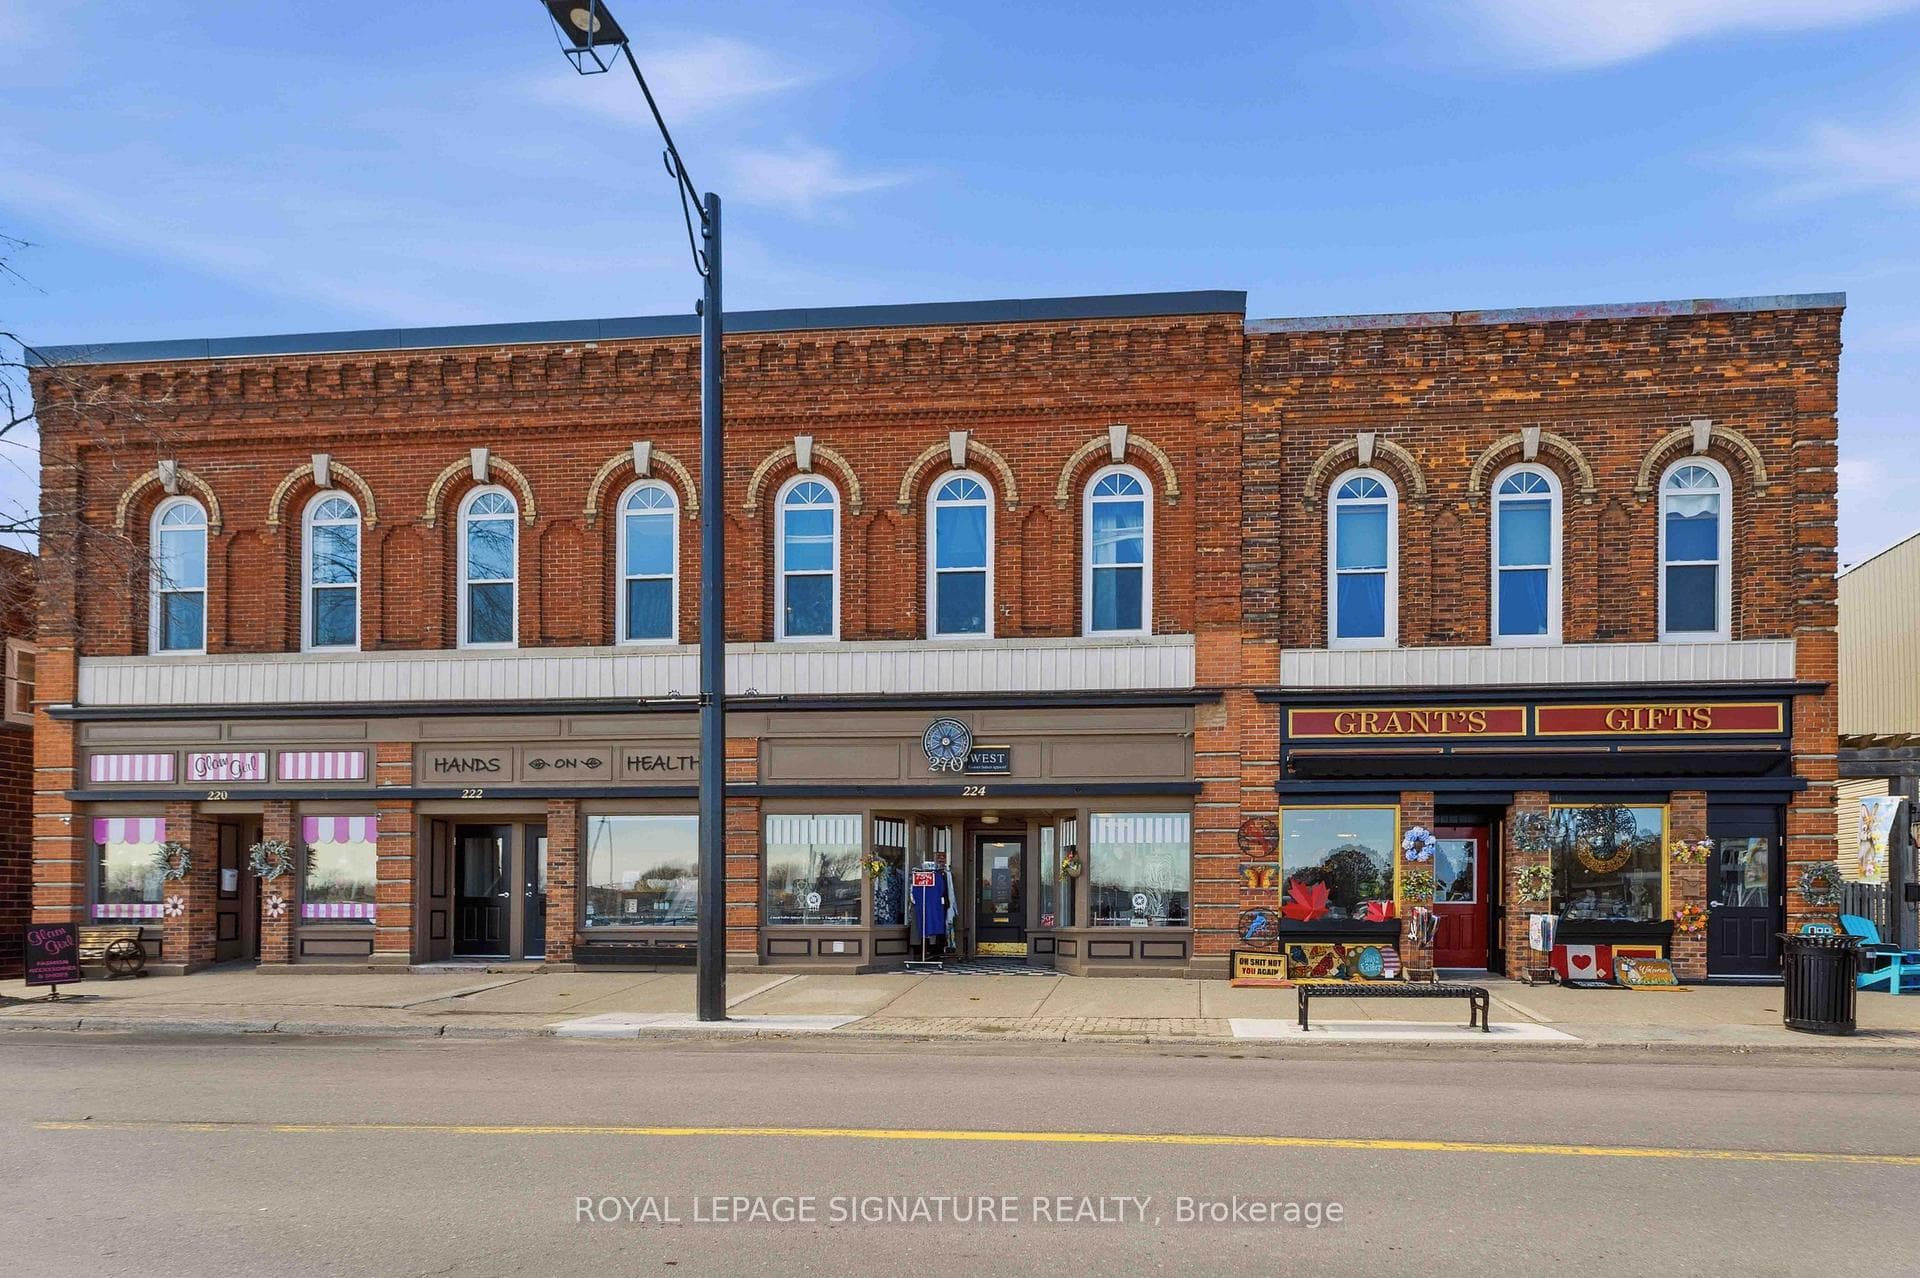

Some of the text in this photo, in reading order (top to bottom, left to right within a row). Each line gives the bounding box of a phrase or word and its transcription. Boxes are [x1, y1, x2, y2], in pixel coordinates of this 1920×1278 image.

[1334, 711, 1488, 734] GRANT'S
[1605, 708, 1712, 730] GIFTS
[434, 757, 501, 773] HANDS
[554, 758, 577, 769] ON
[969, 753, 1006, 764] WEST
[230, 755, 257, 780] Girl
[207, 790, 228, 800] 220
[461, 789, 484, 799] 222
[962, 785, 987, 796] 224
[27, 927, 66, 946] Glam
[45, 934, 75, 955] Girl
[1250, 958, 1266, 966] SHIT
[1241, 967, 1256, 975] YOU
